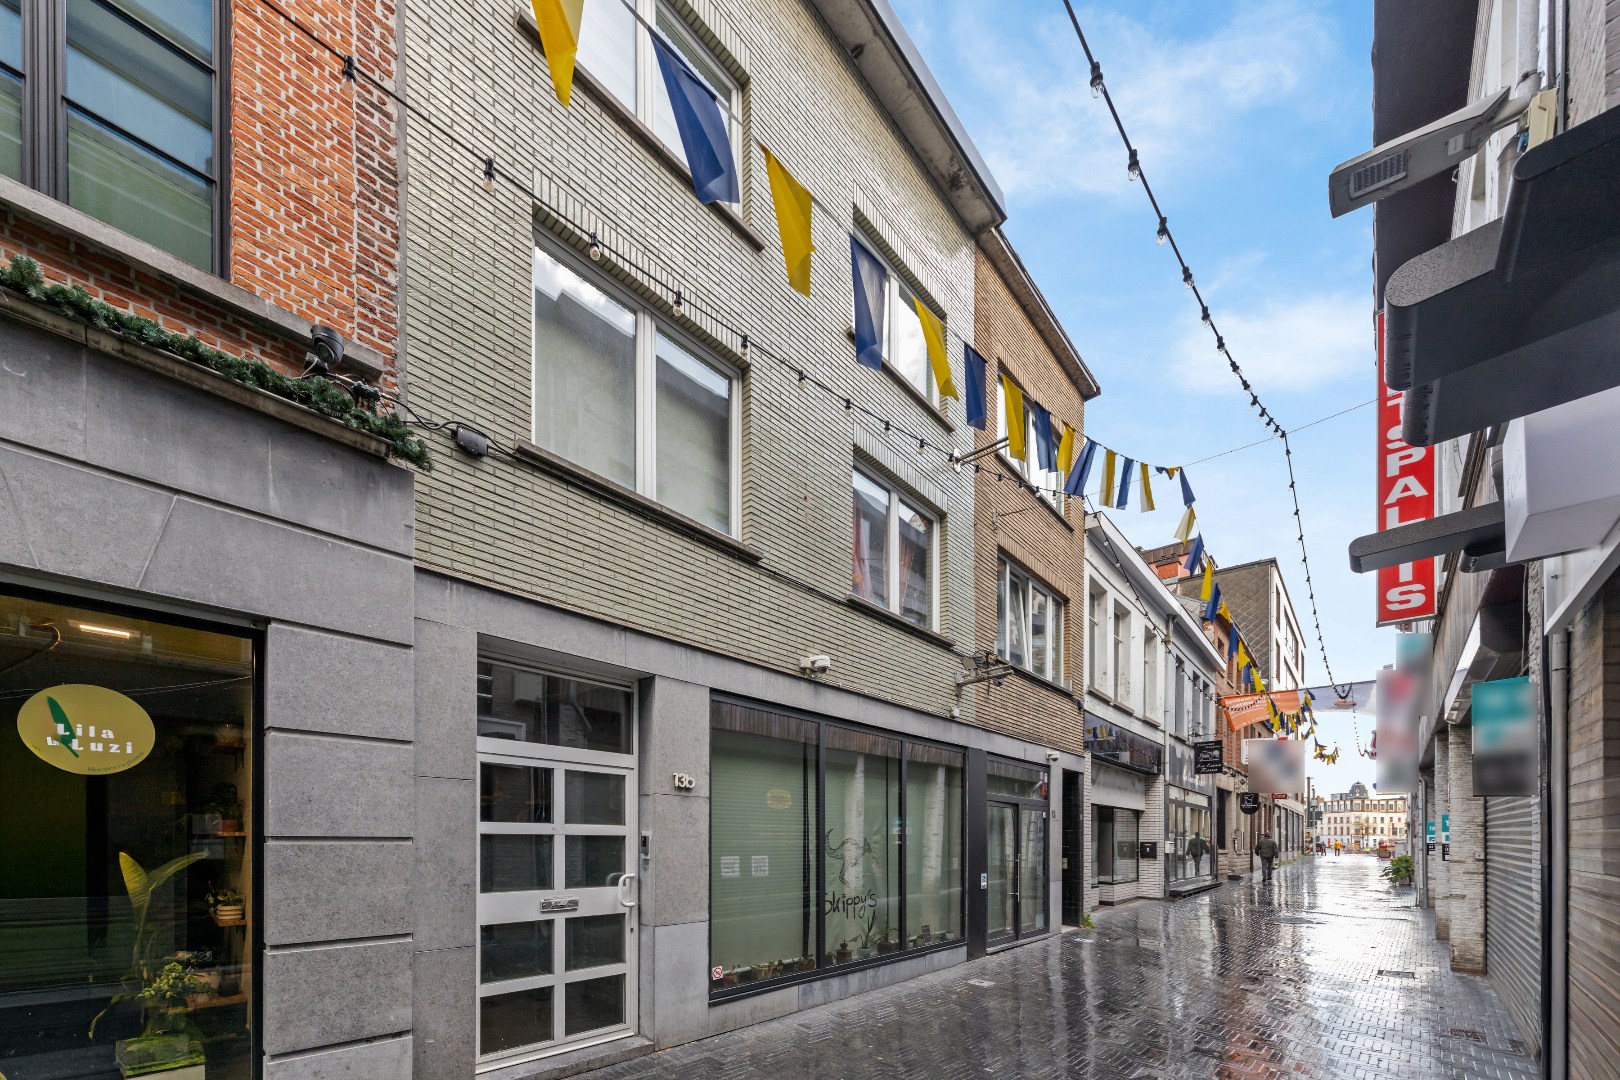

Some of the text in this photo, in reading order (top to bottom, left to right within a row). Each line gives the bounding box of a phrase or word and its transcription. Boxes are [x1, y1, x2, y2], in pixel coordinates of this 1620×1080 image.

[56, 723, 114, 739] Lila
[72, 738, 132, 754] Luzi
[672, 772, 696, 789] 13b
